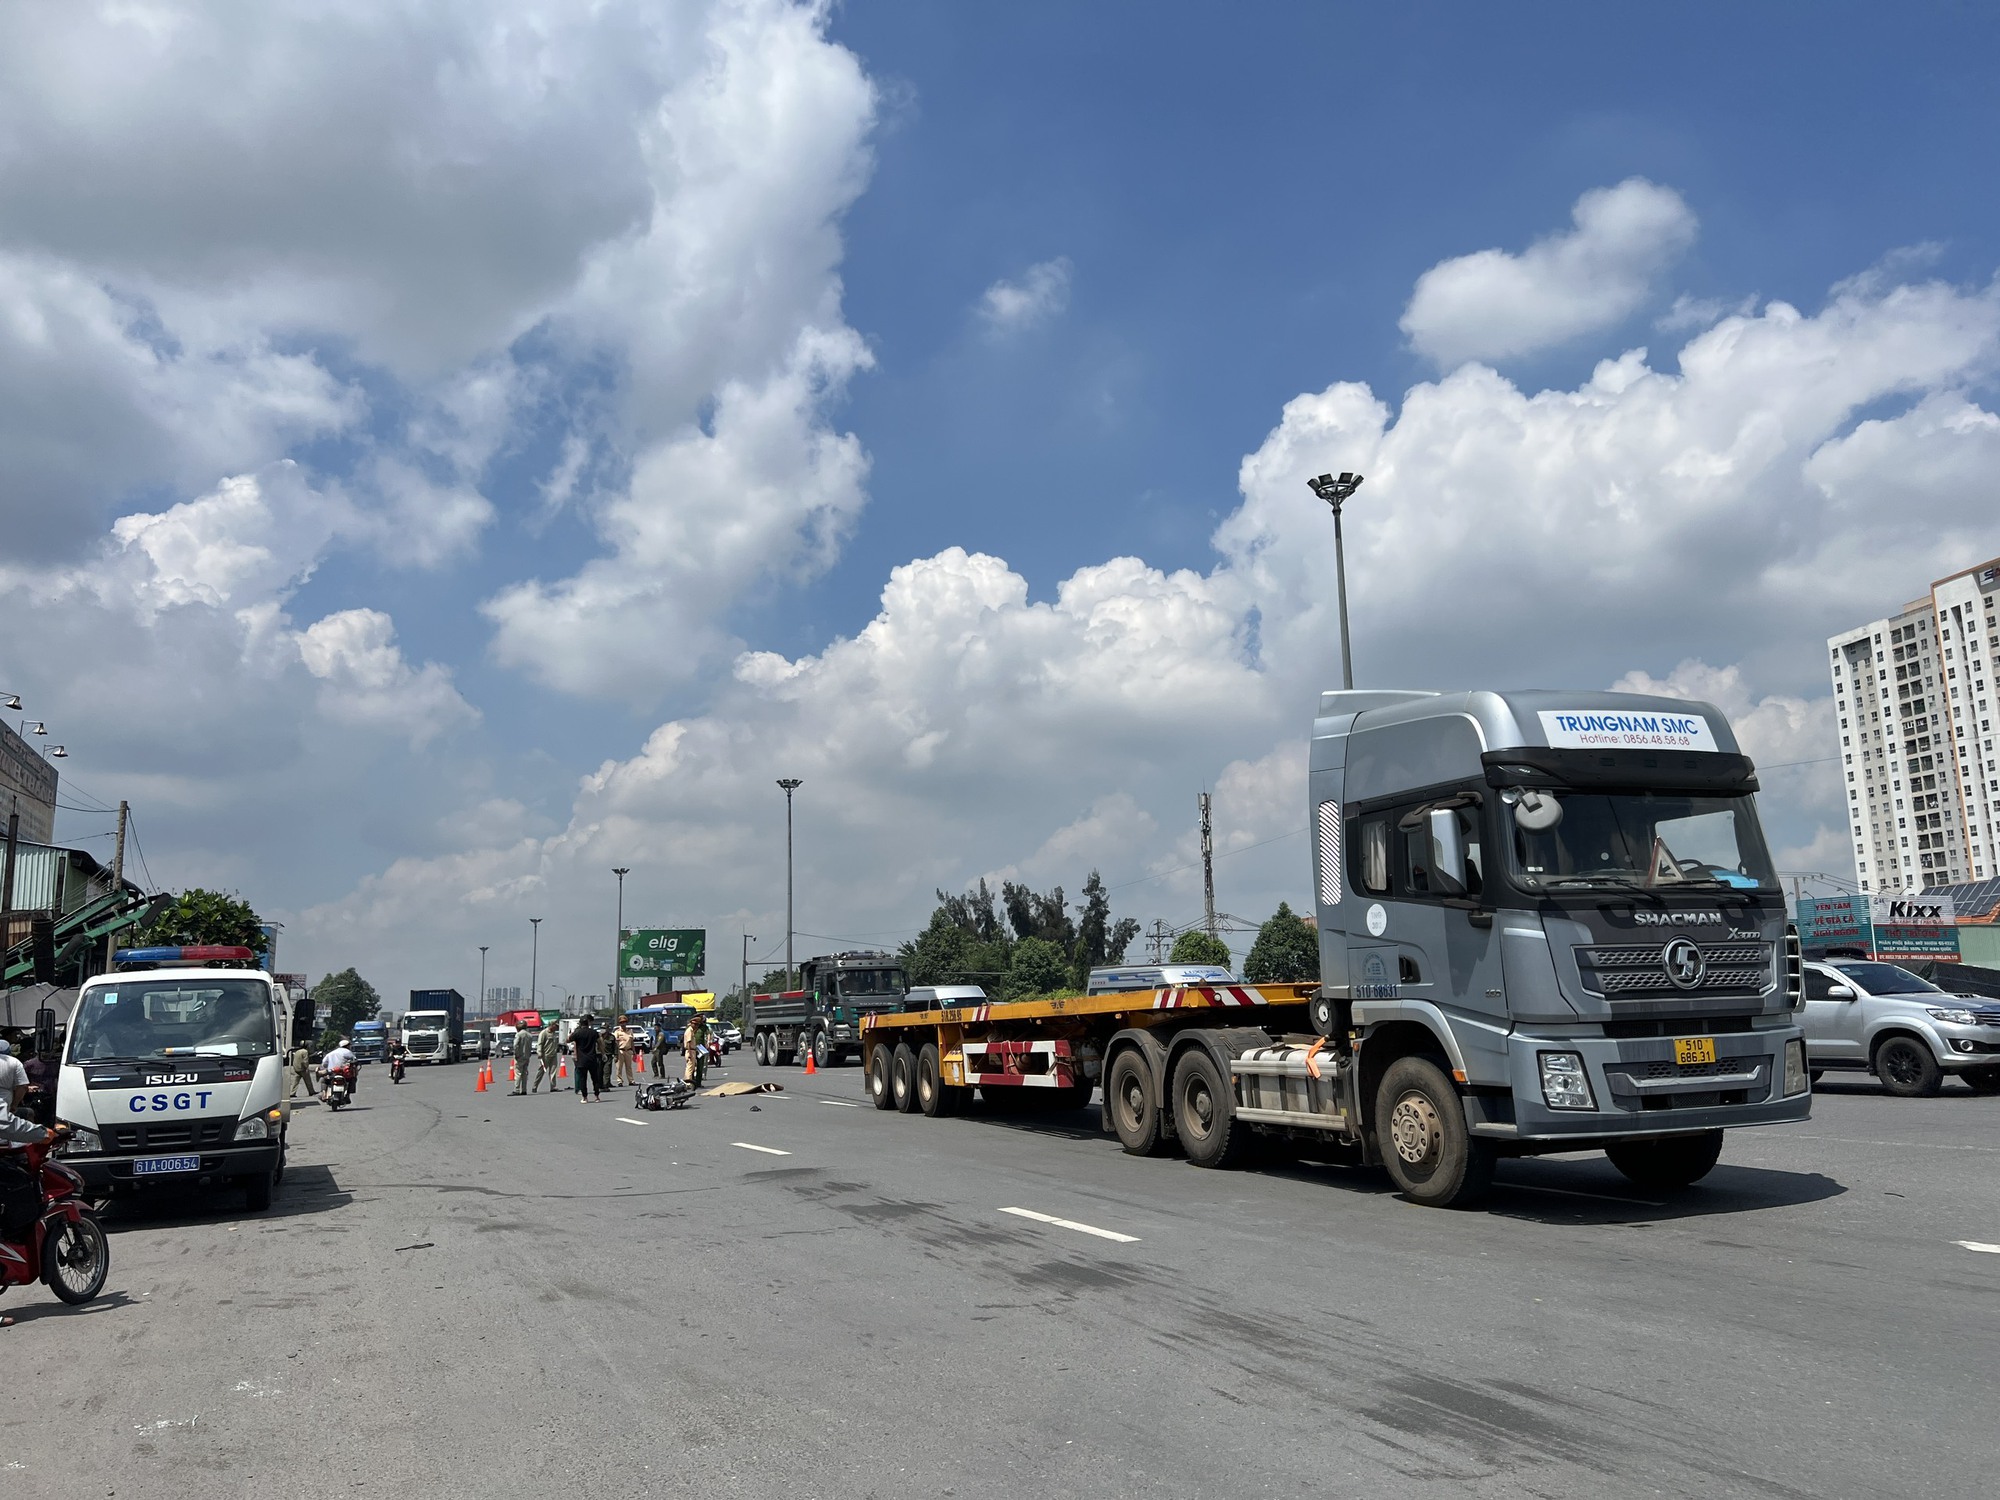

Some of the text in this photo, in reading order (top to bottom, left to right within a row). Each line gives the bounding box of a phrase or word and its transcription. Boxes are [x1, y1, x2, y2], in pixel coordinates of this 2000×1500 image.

[1556, 716, 1698, 735] TRUNGNAM SMC
[1580, 734, 1690, 746] Hotline: 0856.48.58.68
[1888, 901, 1942, 918] Kixx
[1634, 912, 1722, 927] SHACMAN
[1727, 927, 1761, 939] X3000
[648, 935, 679, 952] elig
[1685, 1039, 1703, 1051] 51D
[1680, 1051, 1711, 1063] 686.31
[145, 1073, 199, 1085] ISUZU
[129, 1091, 213, 1113] CSGT
